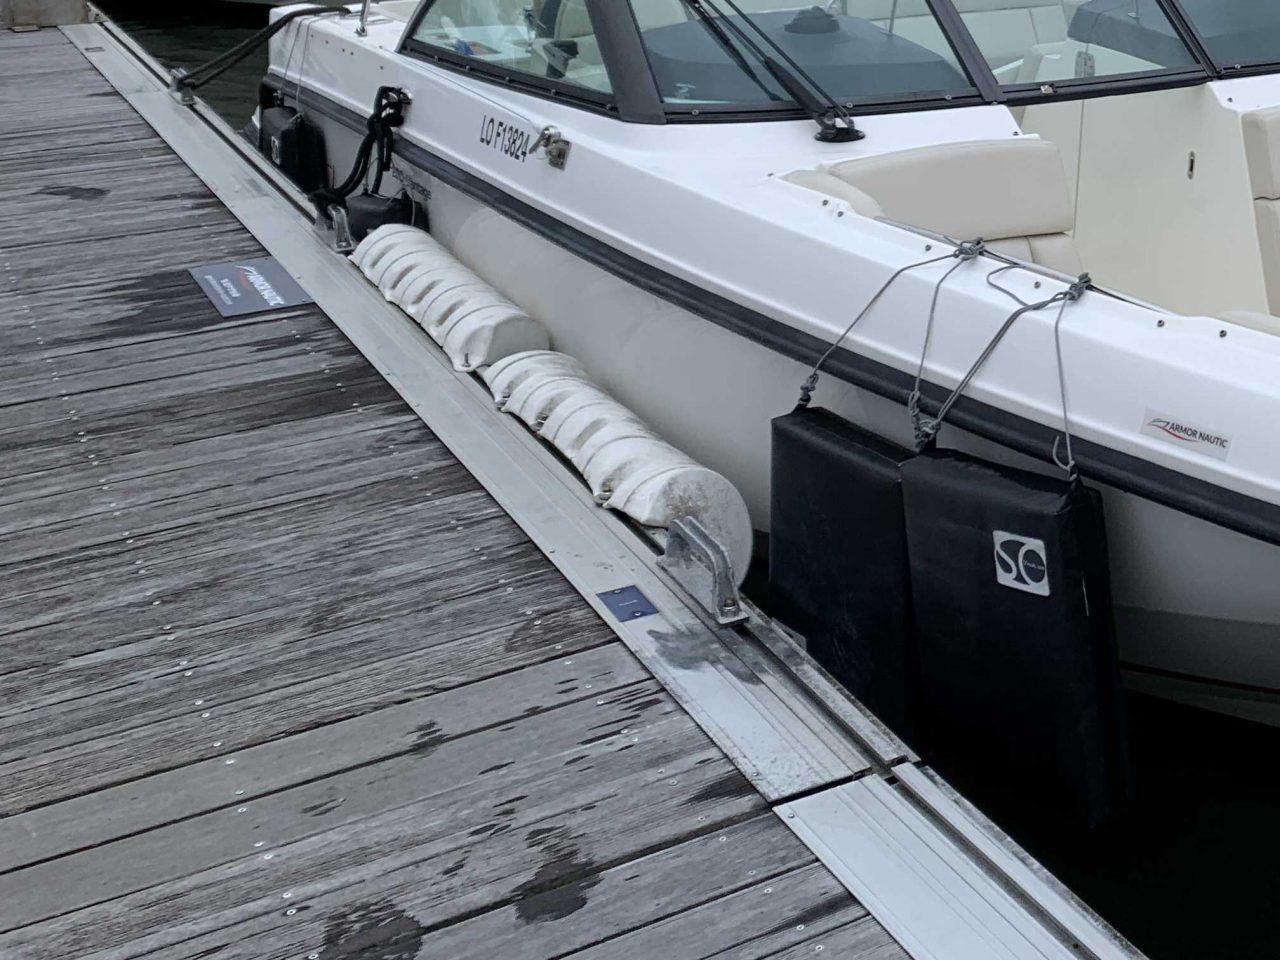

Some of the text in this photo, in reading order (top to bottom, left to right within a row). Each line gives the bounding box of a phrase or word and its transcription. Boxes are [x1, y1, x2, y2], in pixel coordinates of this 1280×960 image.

[480, 114, 530, 163] LO F13824
[1169, 422, 1228, 448] ARMOR NAUTIC
